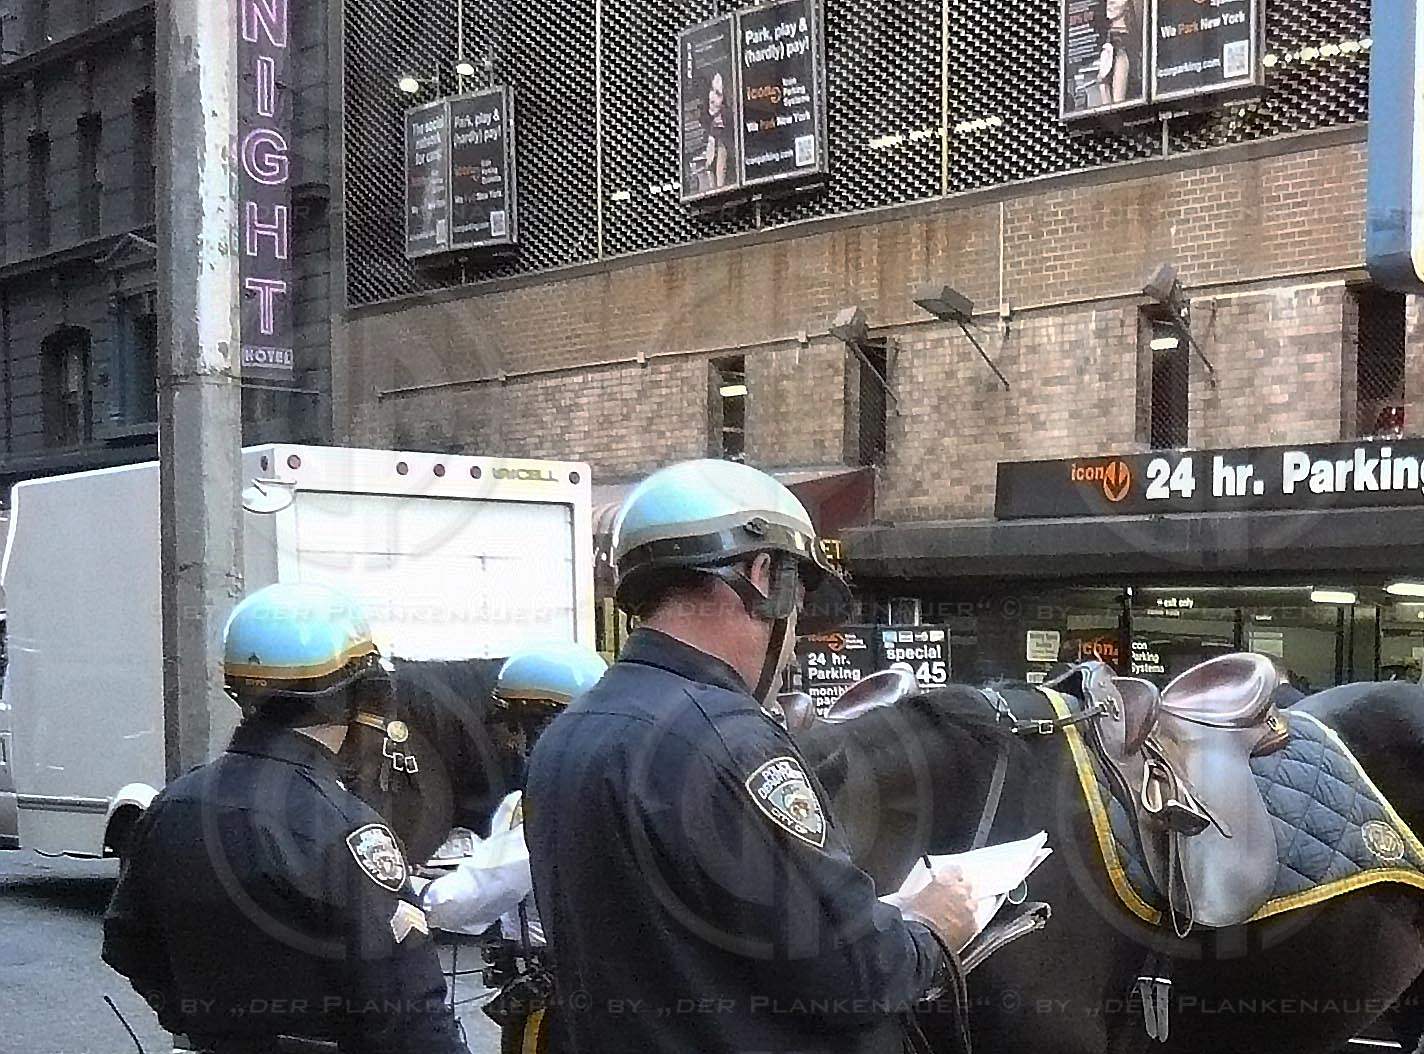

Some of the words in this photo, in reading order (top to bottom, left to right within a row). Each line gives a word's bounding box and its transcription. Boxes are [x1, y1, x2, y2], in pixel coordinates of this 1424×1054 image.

[1200, 16, 1221, 31] New
[1221, 10, 1246, 27] York
[774, 21, 797, 41] play
[241, 0, 289, 335] NIGHT
[245, 349, 292, 365] HOTEL
[1071, 464, 1103, 481] icon
[1145, 457, 1196, 499] 24
[1212, 454, 1264, 497] hr.
[807, 652, 827, 666] 24
[831, 653, 851, 666] hr.
[886, 644, 942, 662] special
[807, 667, 861, 681] Parking
